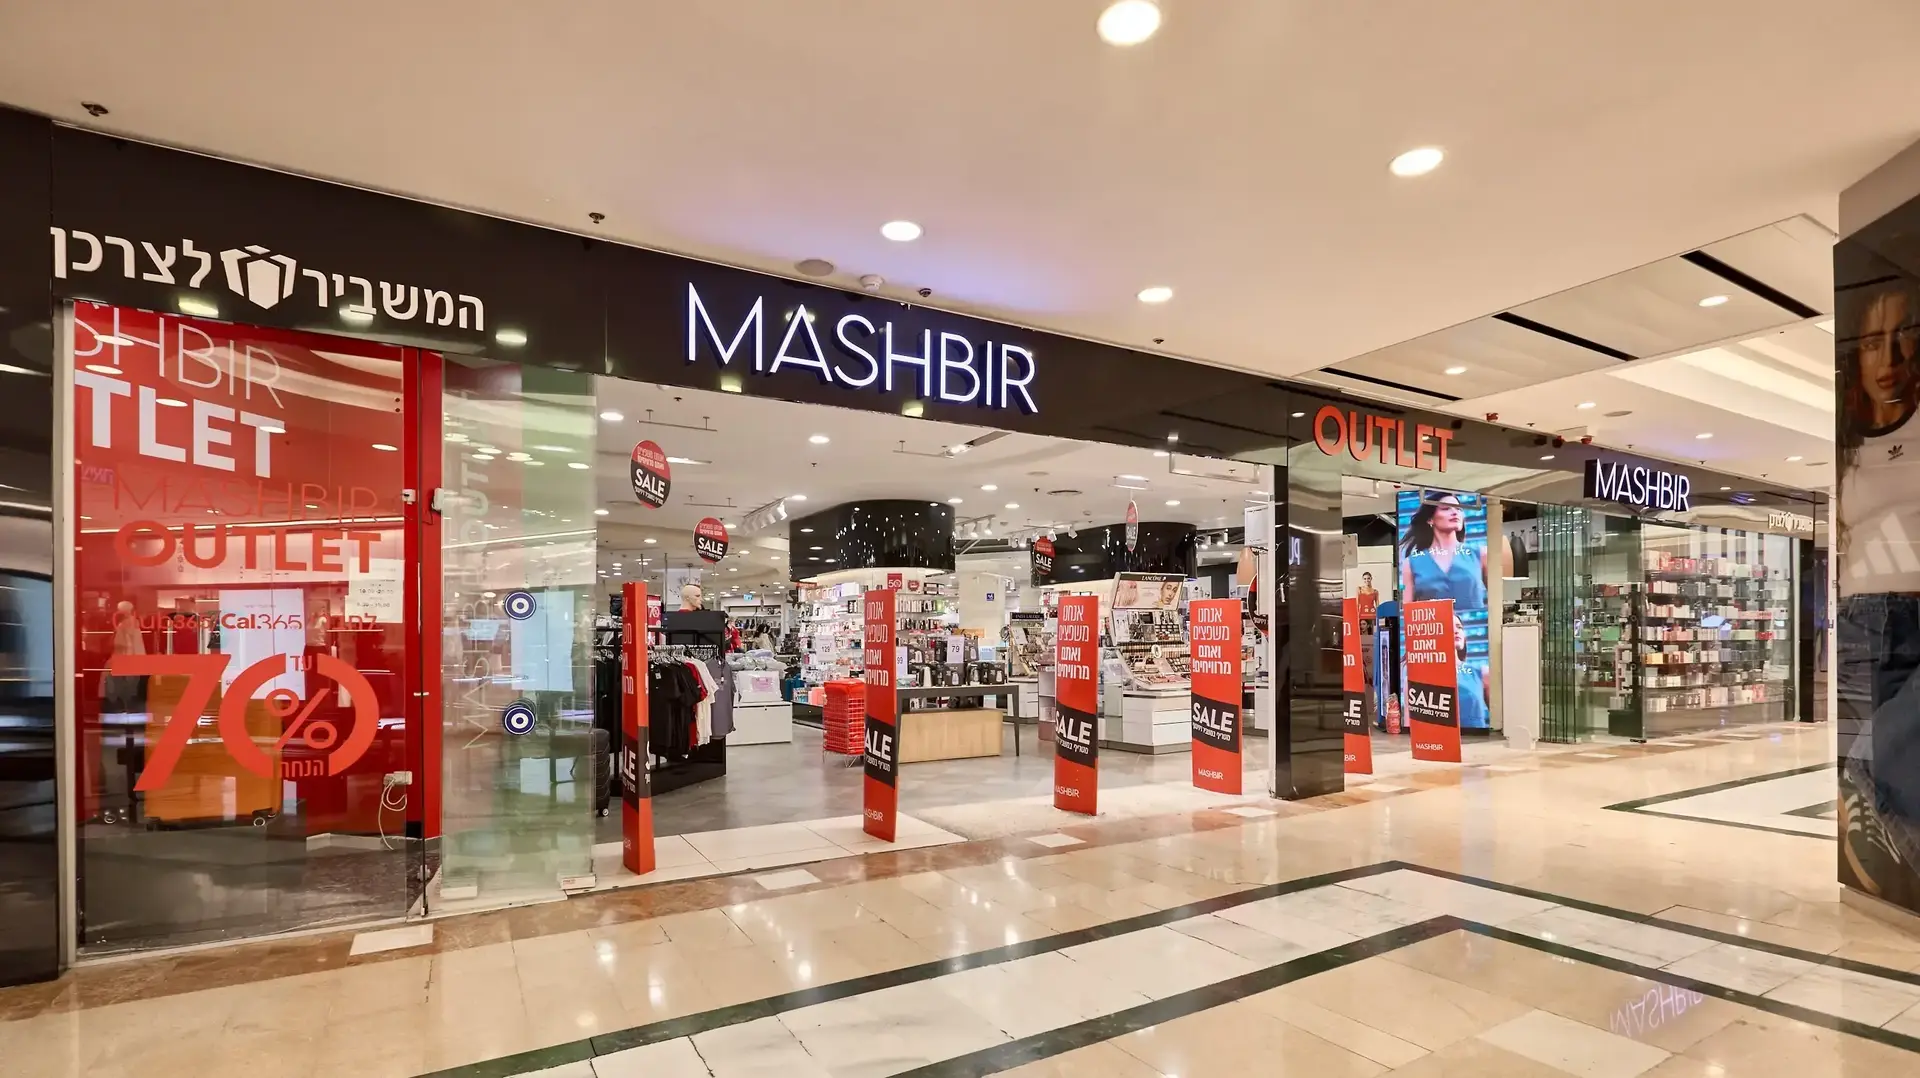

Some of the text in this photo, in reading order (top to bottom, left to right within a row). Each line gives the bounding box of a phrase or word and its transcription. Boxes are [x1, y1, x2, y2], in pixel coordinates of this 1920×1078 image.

[50, 226, 485, 331] המשביר לצרכן
[75, 302, 285, 409] SHBIR
[686, 281, 1039, 413] MASHBIR
[75, 370, 285, 478] TLET
[1313, 404, 1453, 473] OUTLET
[635, 468, 666, 498] SALE
[1595, 458, 1690, 512] MASHBIR
[114, 463, 379, 525] MASHBIR
[116, 520, 382, 574] OUTLET
[698, 537, 724, 555] SALE
[1036, 553, 1053, 568] SALE
[1198, 607, 1223, 623] אנחנו
[1411, 608, 1436, 621] אנחנו
[1193, 625, 1230, 641] משפצים
[1407, 622, 1444, 636] משפצים
[951, 645, 960, 653] 79
[1061, 645, 1081, 662] ואתם
[1198, 645, 1221, 658] ואתם
[1413, 639, 1437, 651] ואתם
[1192, 658, 1232, 674] מרוויחים!
[1407, 651, 1447, 664] מרוויחים!
[1408, 687, 1452, 711] SALE
[1055, 710, 1093, 745] SALE
[1193, 702, 1235, 733] SALE
[865, 727, 892, 761] ALE
[1415, 742, 1444, 751] MASHBIR
[624, 745, 637, 781] LE
[1198, 767, 1224, 780] MASHBIR
